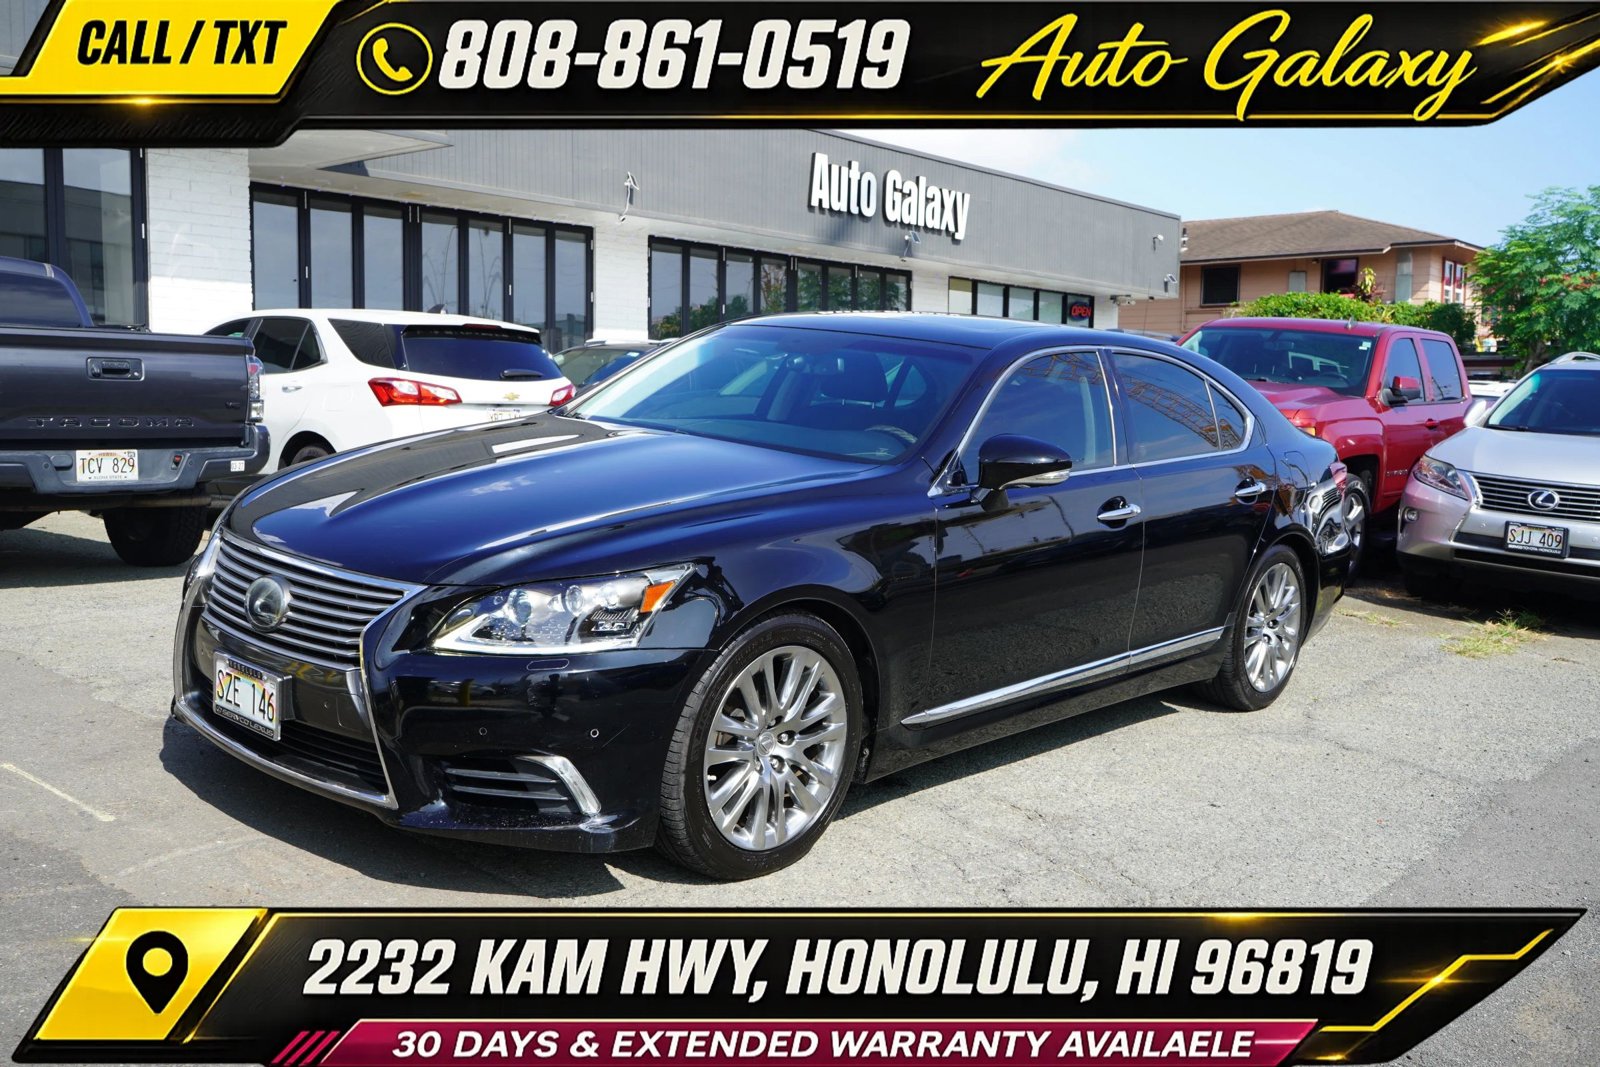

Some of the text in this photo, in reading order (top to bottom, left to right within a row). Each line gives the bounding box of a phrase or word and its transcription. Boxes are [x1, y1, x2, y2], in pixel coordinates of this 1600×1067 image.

[809, 152, 971, 241] Auto Galaxy
[1071, 303, 1092, 318] OPEN
[27, 417, 194, 428] TACOMA
[80, 457, 135, 474] TCV 829
[1509, 529, 1563, 548] SJJ 409
[217, 669, 275, 721] SZE 146
